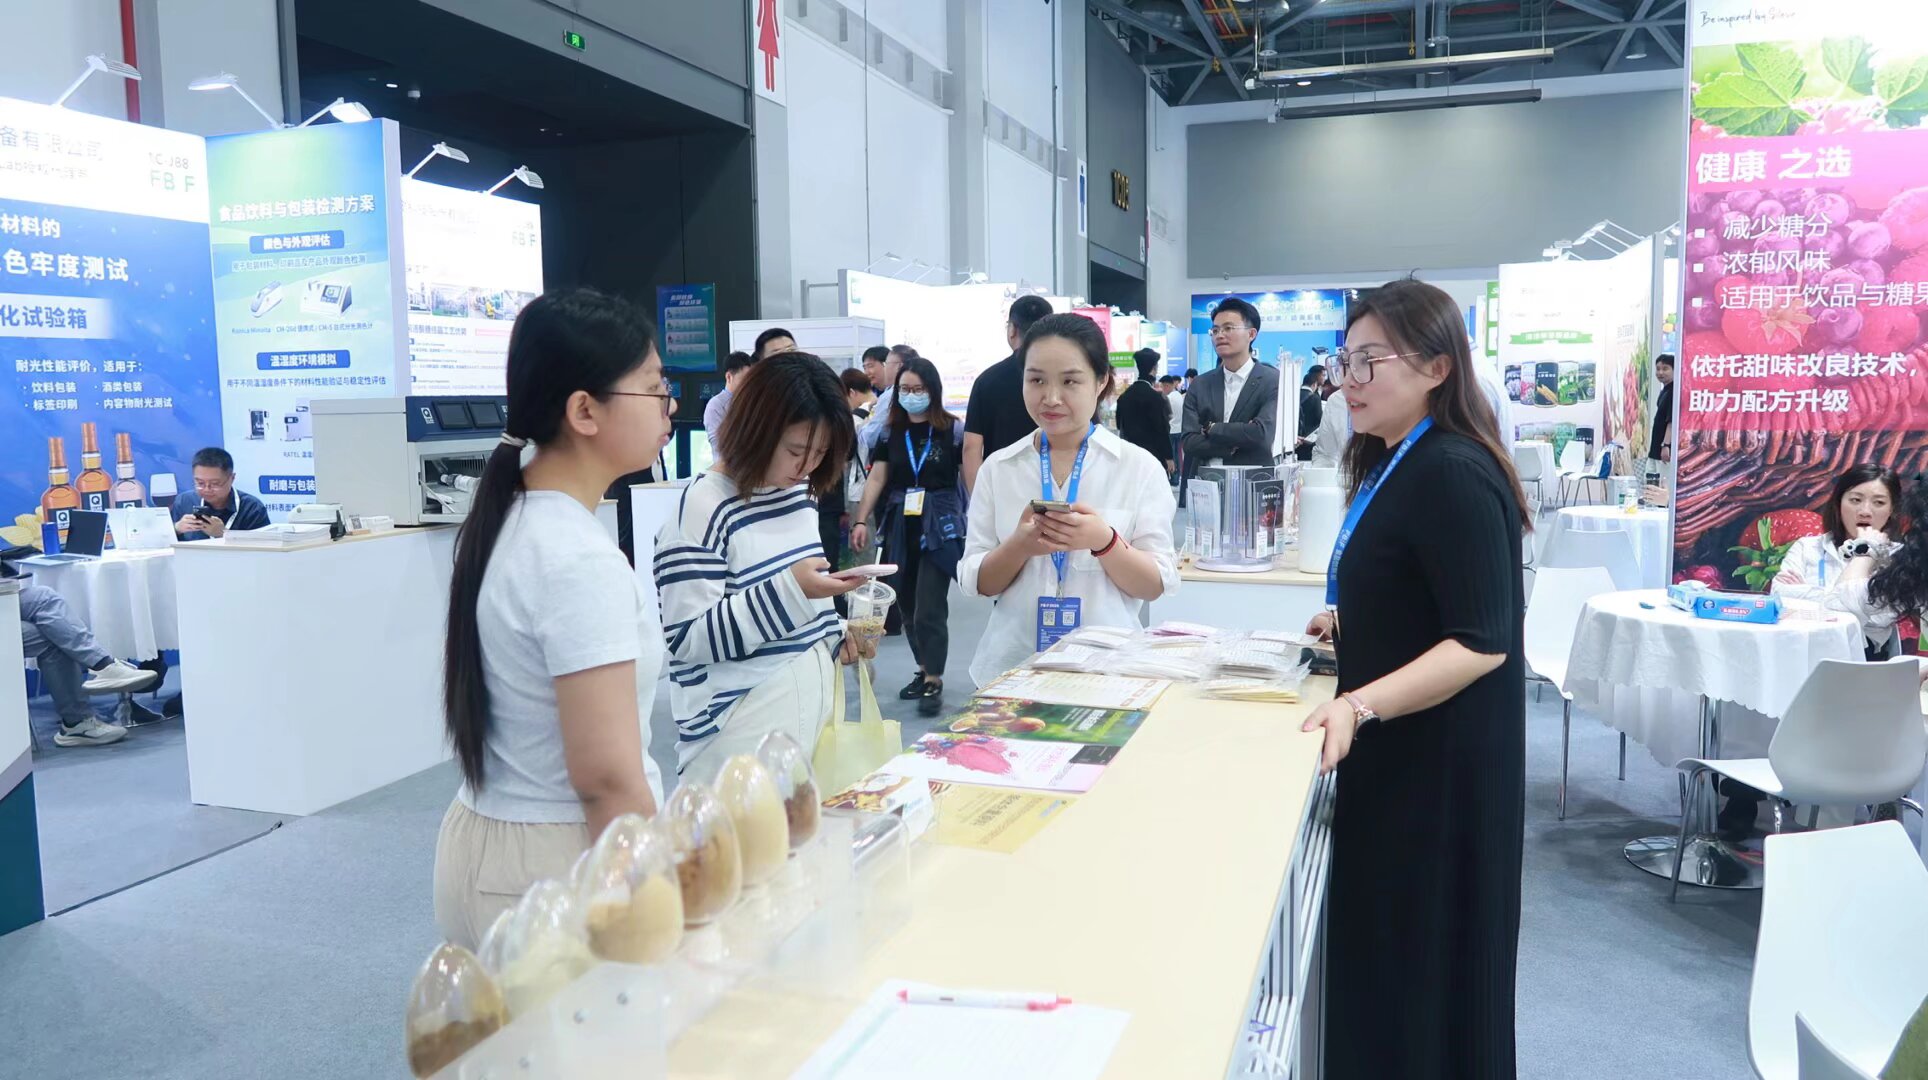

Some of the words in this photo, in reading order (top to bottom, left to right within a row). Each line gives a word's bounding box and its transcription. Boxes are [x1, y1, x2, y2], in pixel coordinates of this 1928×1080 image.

[1696, 150, 1767, 184] 健康
[1778, 146, 1851, 180] 之选
[219, 194, 375, 222] 食品饮料与包装检测方案
[0, 213, 61, 238] 材料的
[1723, 212, 1832, 240] 减少糖分
[263, 234, 331, 250] 颜色与外观评估
[3, 248, 129, 282] 色牢度测试
[1722, 249, 1831, 275] 浓郁风味
[1720, 281, 1928, 310] 适用于饮品与糖果
[0, 304, 87, 329] 化试验箱
[270, 353, 337, 367] 温湿度环境模拟
[1690, 352, 1917, 378] 依托甜味改良技术，
[32, 382, 77, 393] 饮料包装
[102, 382, 143, 393] 酒类包装
[33, 399, 78, 411] 标签印刷
[103, 397, 173, 410] 内容物耐光测试
[1689, 389, 1850, 413] 助力配方升级
